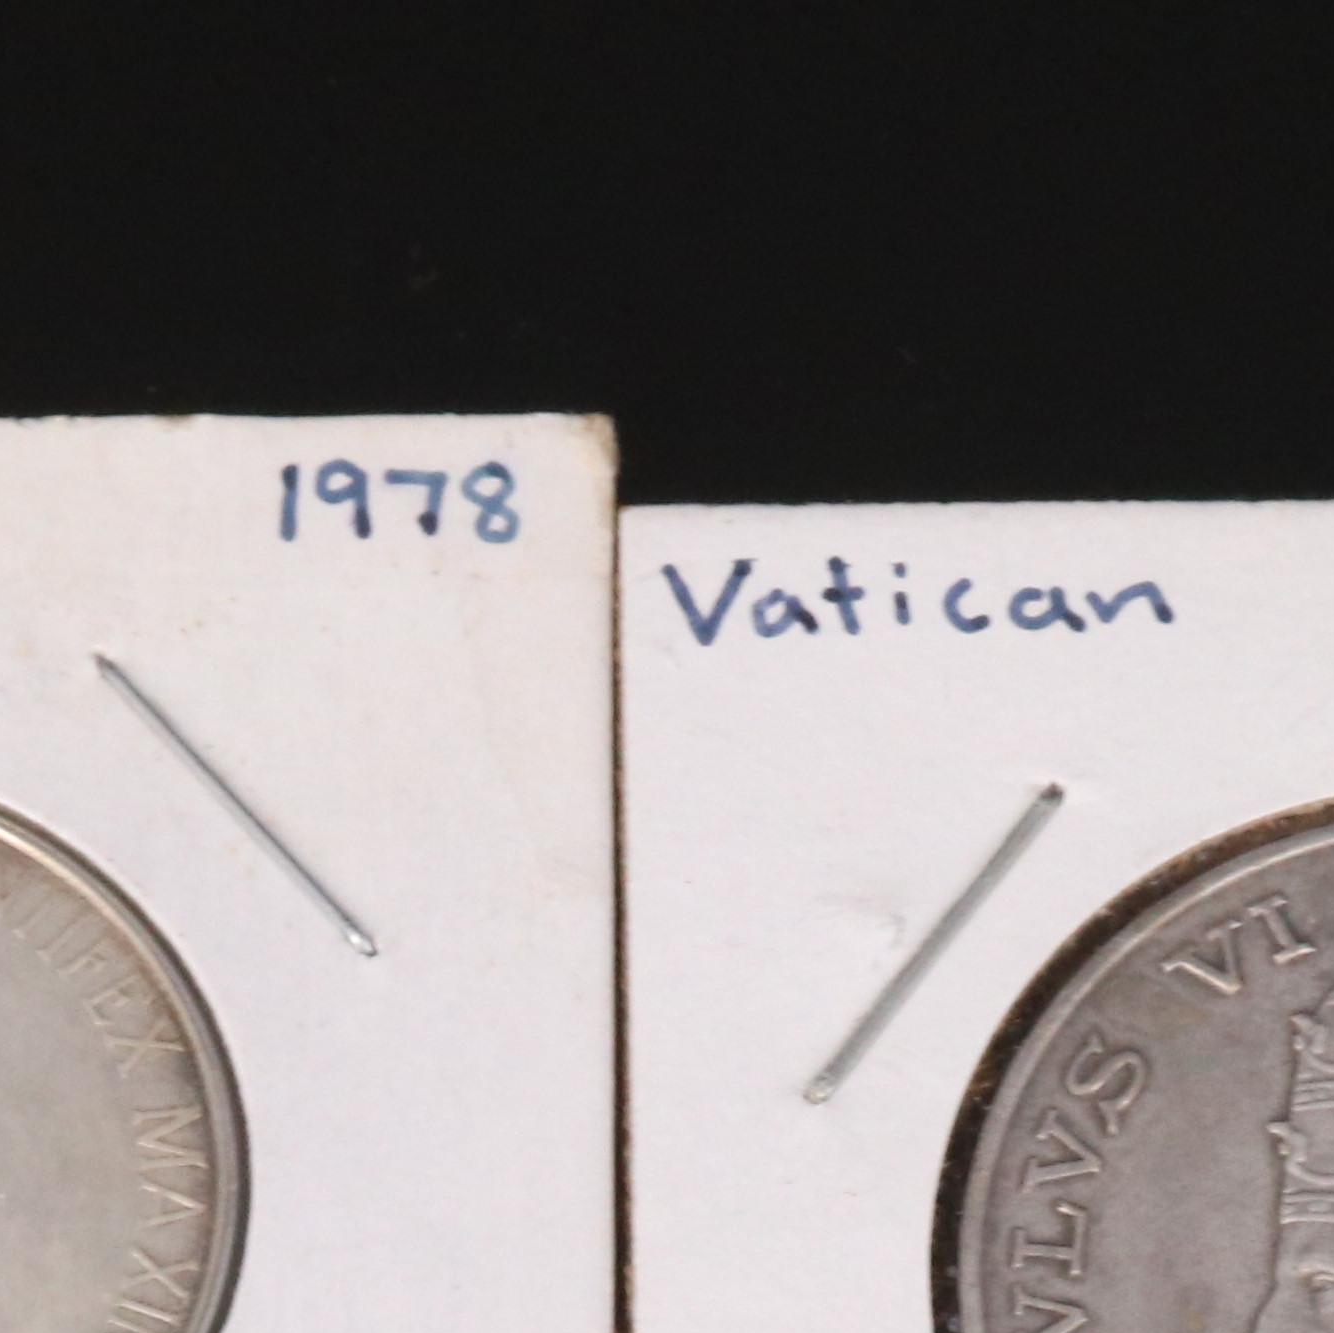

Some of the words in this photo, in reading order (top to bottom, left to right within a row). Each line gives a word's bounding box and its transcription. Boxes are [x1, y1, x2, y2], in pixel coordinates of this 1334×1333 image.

[280, 459, 518, 543] 1978
[661, 556, 1174, 646] Vatican
[1161, 892, 1320, 998] VI
